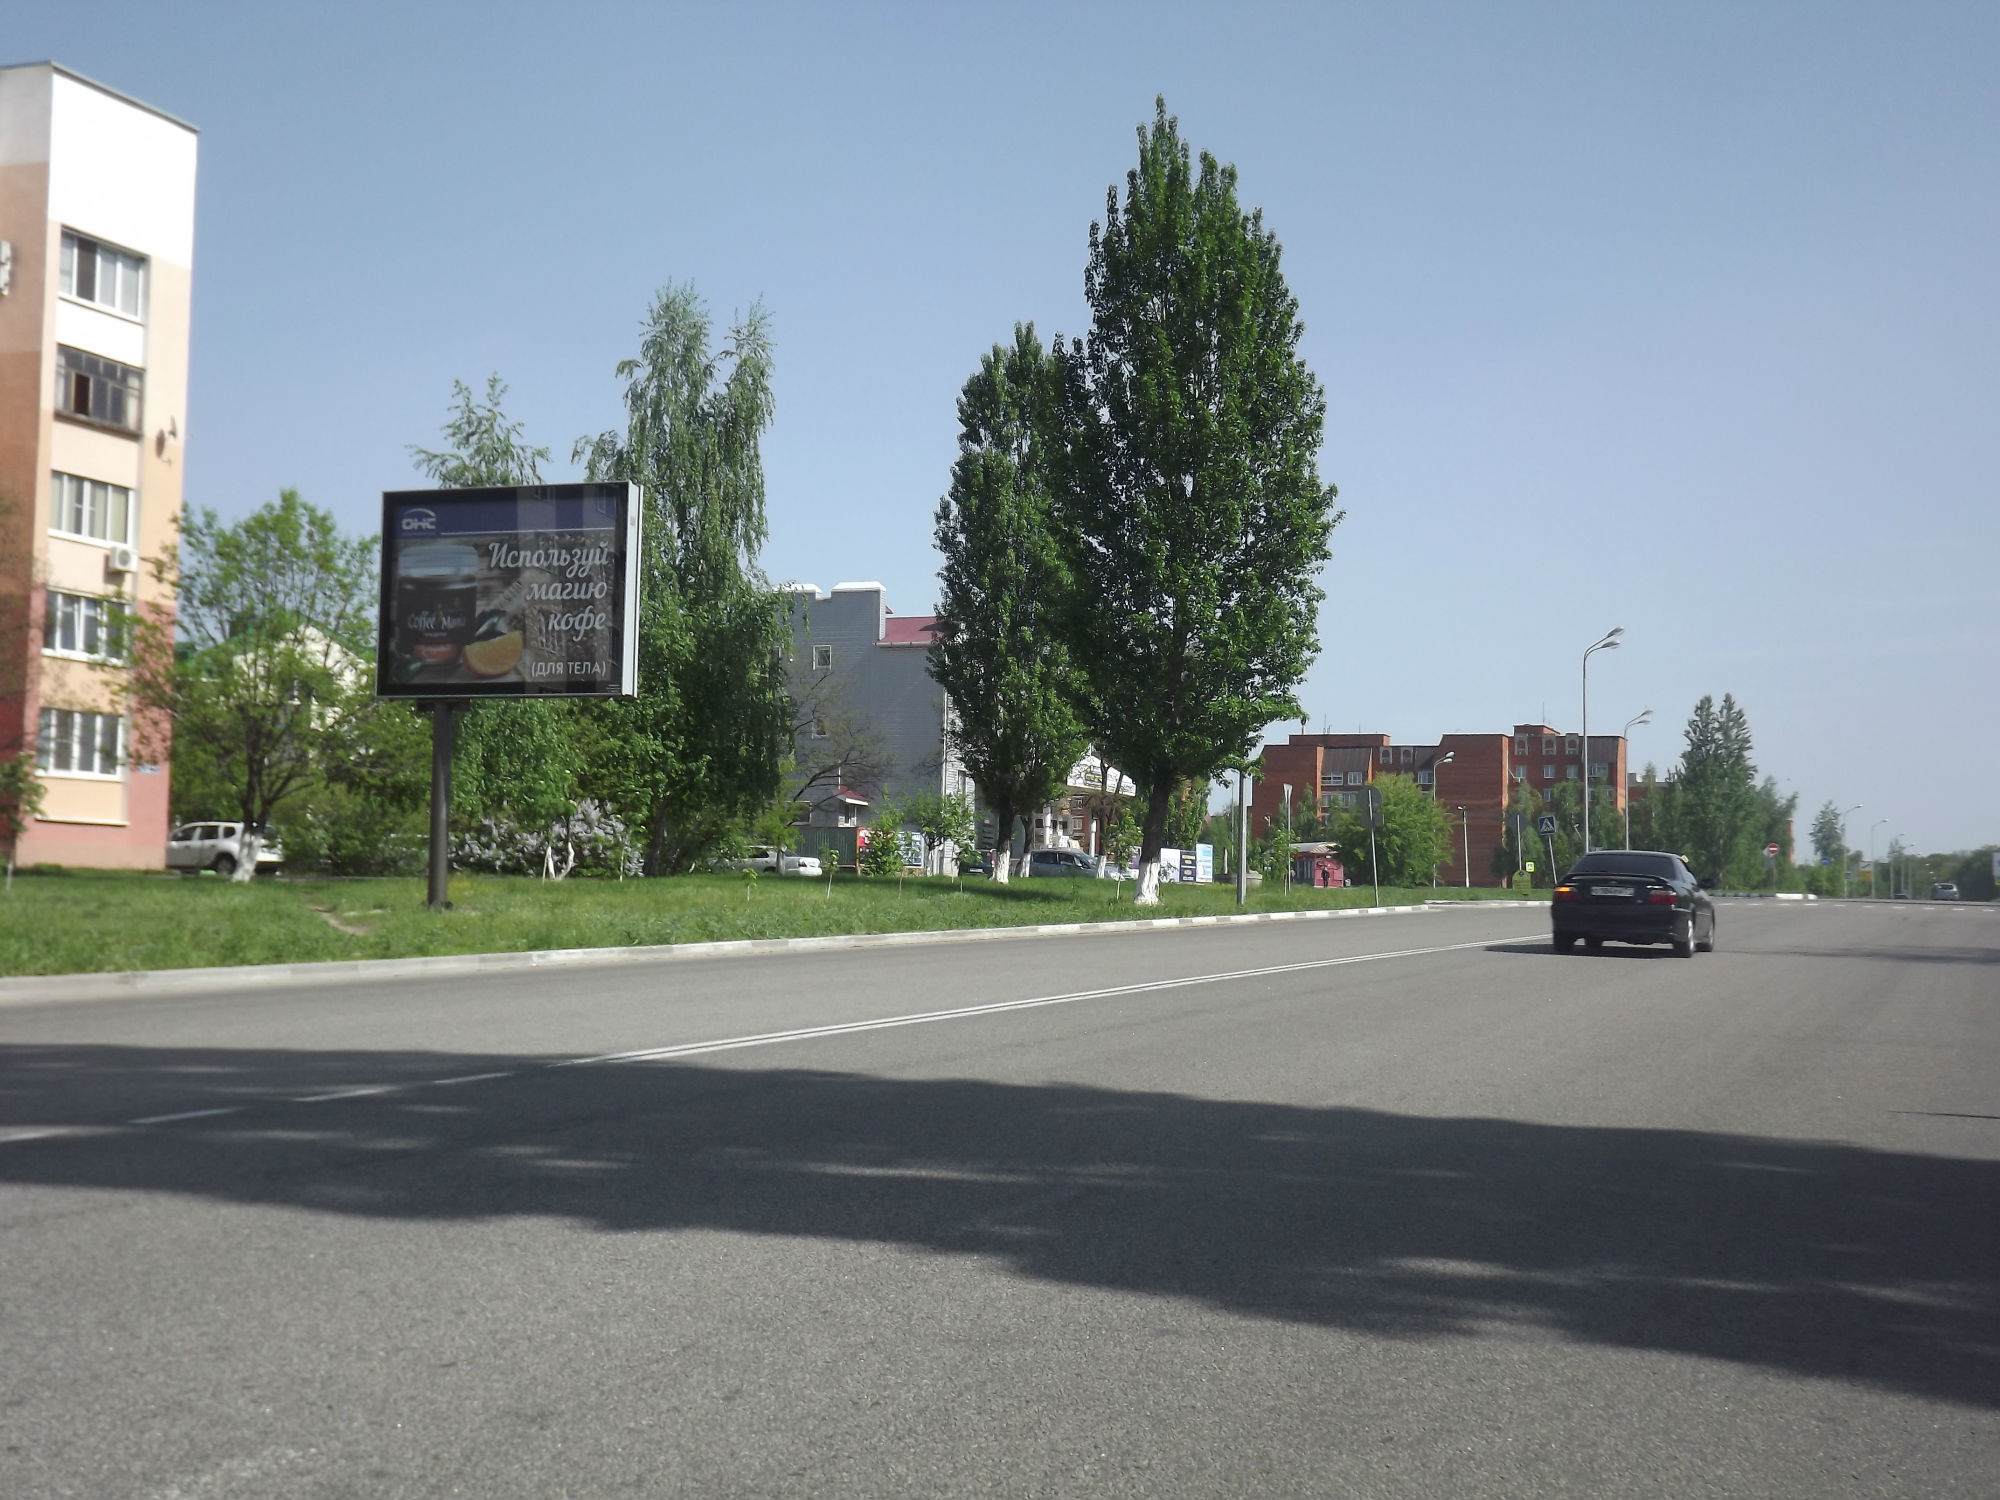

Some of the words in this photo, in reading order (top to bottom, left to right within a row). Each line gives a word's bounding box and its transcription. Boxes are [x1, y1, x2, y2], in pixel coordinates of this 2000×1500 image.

[488, 542, 609, 578] Используй
[526, 580, 608, 601] магию
[548, 605, 607, 642] кофе
[531, 661, 564, 678] (ДЛЯ
[567, 661, 606, 678] ТЕЛА)
